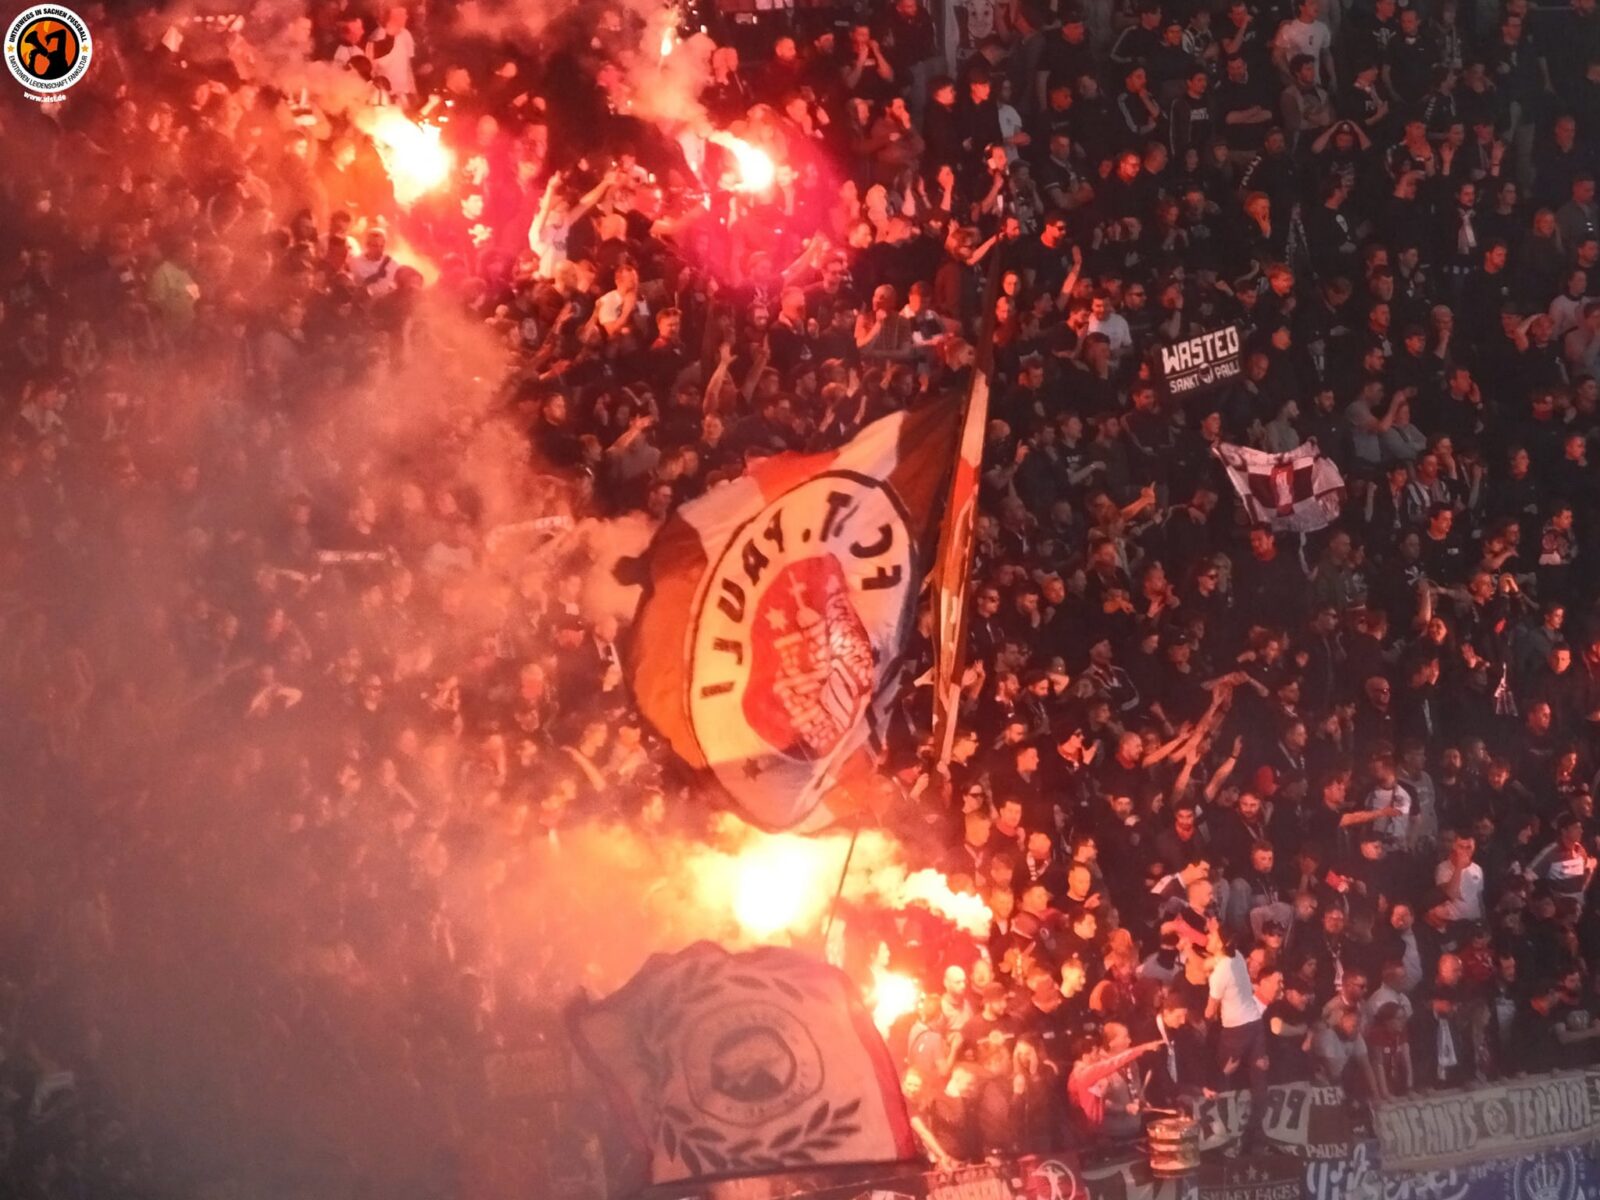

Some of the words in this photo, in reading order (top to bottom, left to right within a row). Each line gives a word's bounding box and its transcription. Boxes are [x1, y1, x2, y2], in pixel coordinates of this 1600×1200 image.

[1161, 325, 1239, 375] WASTED
[1170, 373, 1200, 393] SANKT
[1214, 361, 1241, 379] PAULI
[1378, 1097, 1478, 1157] ENFANTS
